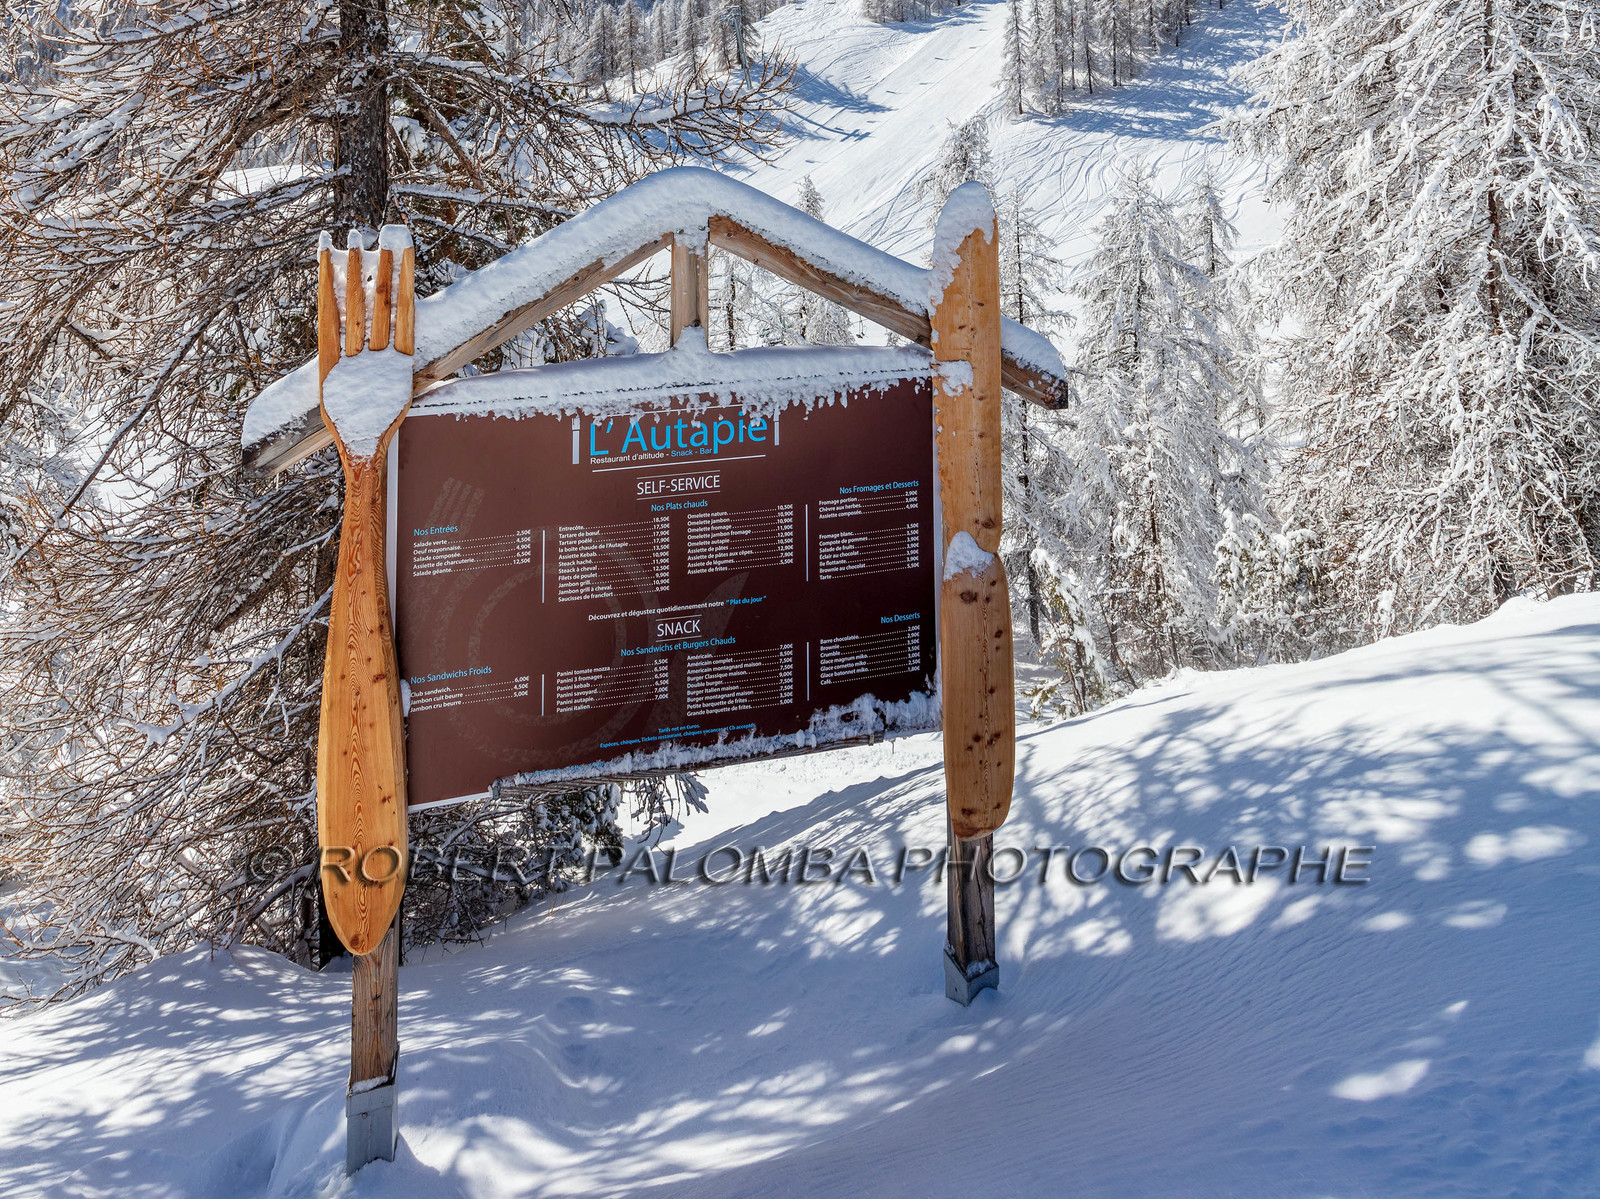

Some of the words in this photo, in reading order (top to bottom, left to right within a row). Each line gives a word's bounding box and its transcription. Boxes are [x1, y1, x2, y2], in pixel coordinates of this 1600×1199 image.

[590, 455, 630, 464] Restaurant
[632, 452, 664, 461] d'altitude
[671, 449, 693, 457] Snack
[637, 475, 721, 495] SELF-SERVICE
[853, 484, 884, 492] Fromages
[893, 480, 919, 489] Desserts
[651, 503, 664, 512] Nos
[666, 502, 682, 510] Plats
[683, 500, 708, 509] chauds
[414, 528, 428, 536] Nos
[430, 525, 458, 534] Entrées
[428, 545, 460, 554] mayonnaise
[433, 553, 460, 561] composée
[444, 557, 474, 565] charcuterie
[432, 568, 451, 576] géante
[588, 613, 620, 621] Découvrez
[628, 608, 655, 617] dégustez
[657, 603, 707, 614] quotidiennement
[881, 616, 893, 624] Nos
[894, 612, 920, 622] Desserts
[657, 620, 700, 637] SNACK
[621, 649, 634, 657] Nos
[636, 643, 673, 654] Sandwichs
[683, 640, 709, 650] Burgers
[710, 636, 736, 646] Chauds
[427, 670, 467, 682] Sandwichs
[469, 666, 491, 675] Froids
[424, 687, 450, 695] sandwich
